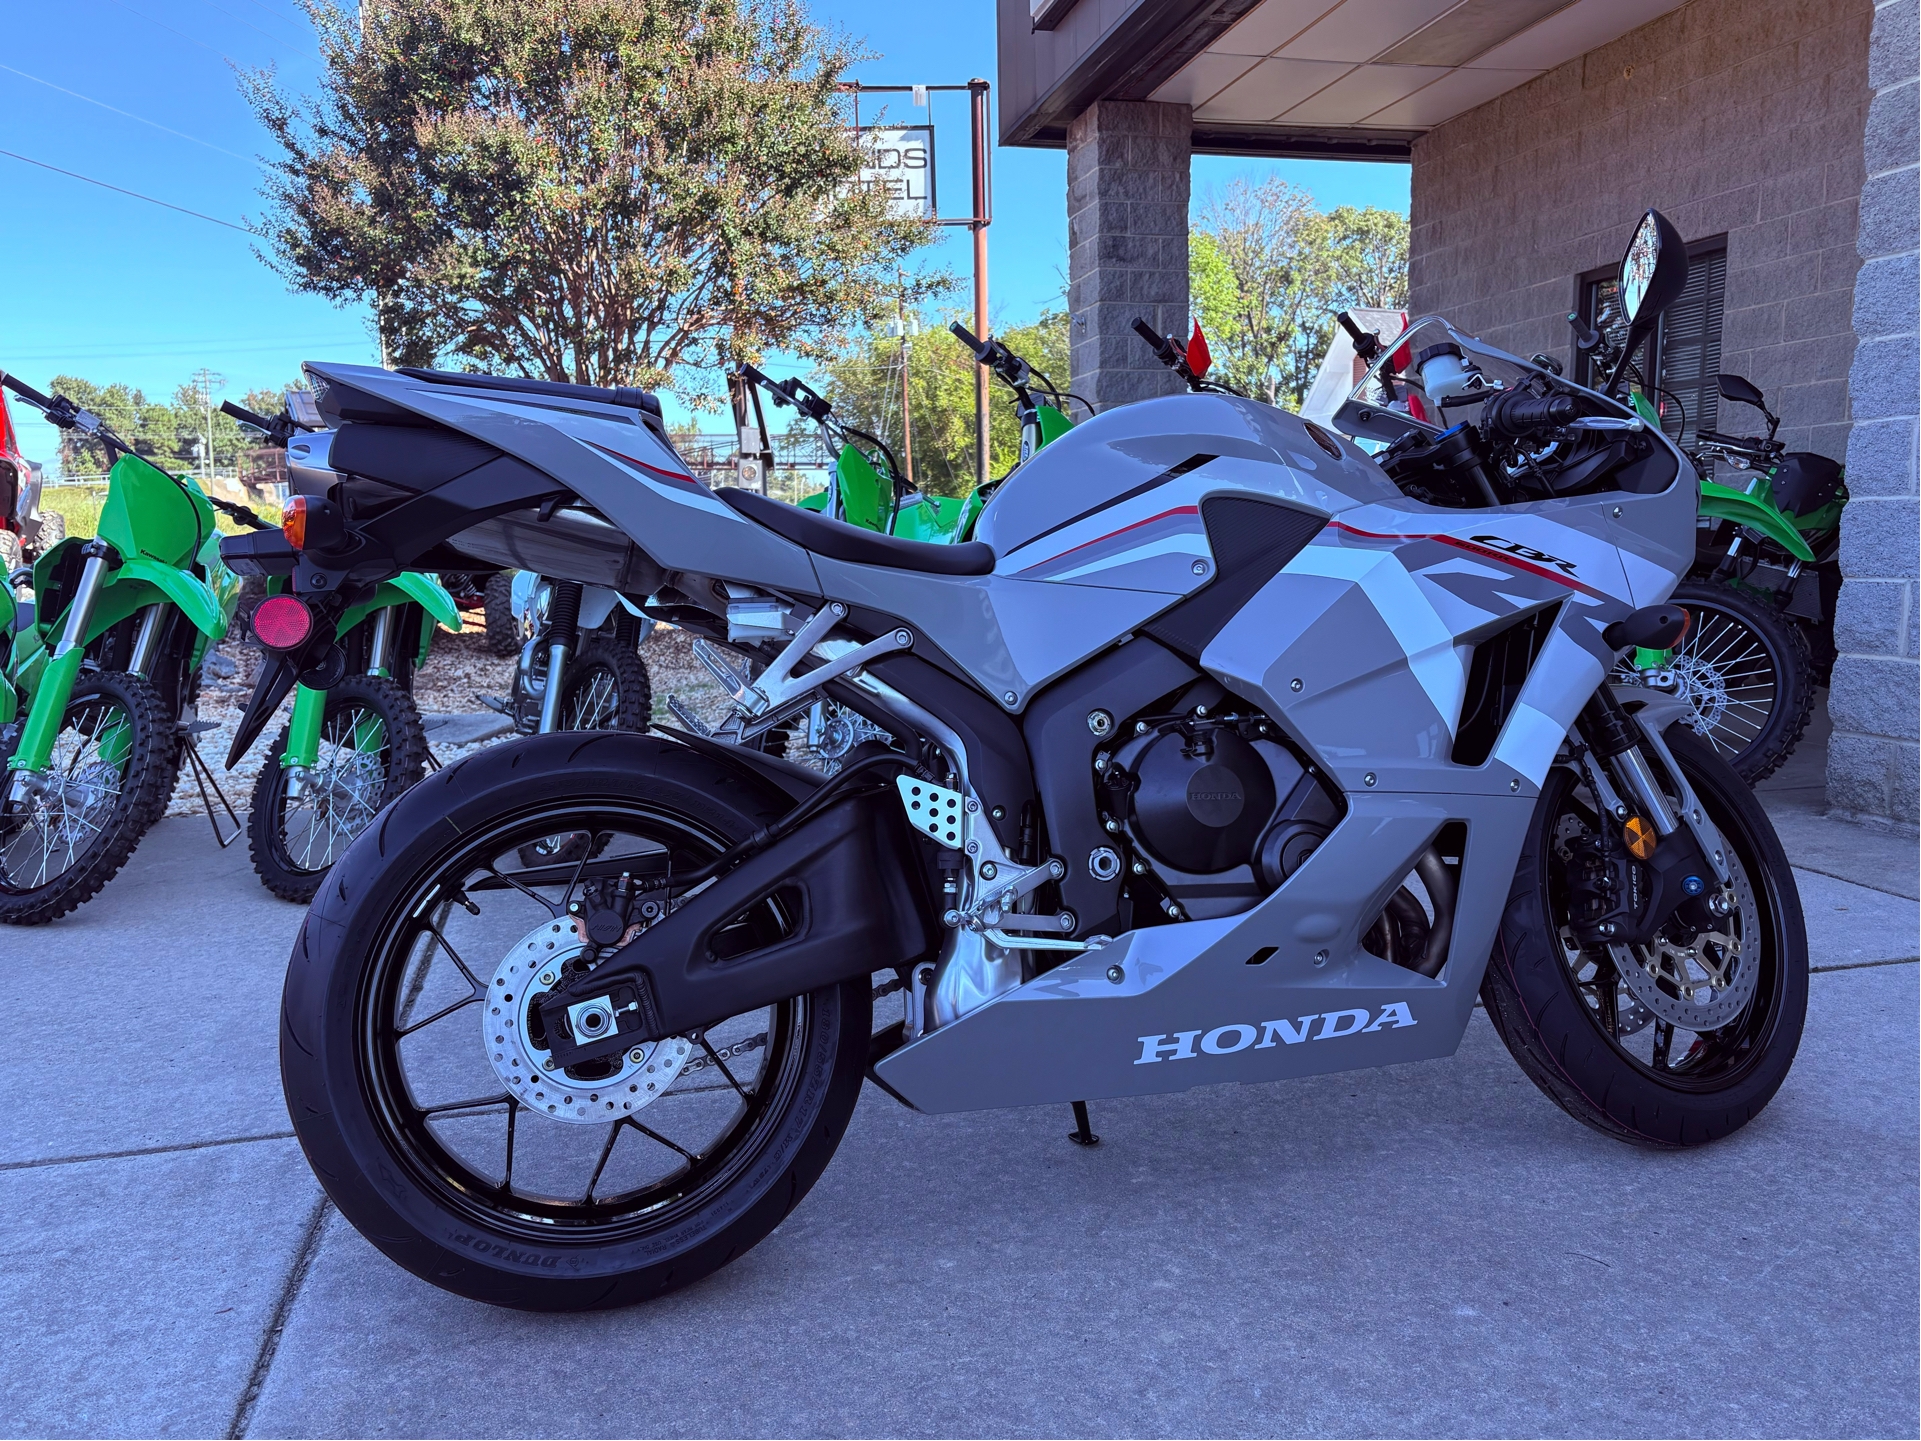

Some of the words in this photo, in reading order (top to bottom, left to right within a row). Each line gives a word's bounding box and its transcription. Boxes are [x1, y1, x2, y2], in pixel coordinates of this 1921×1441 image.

[1469, 535, 1580, 579] CBR
[537, 777, 683, 802] SPORTMAX
[1190, 791, 1242, 801] HONDA
[1133, 1001, 1418, 1065] HONDA
[455, 1234, 562, 1267] DUNLOP
